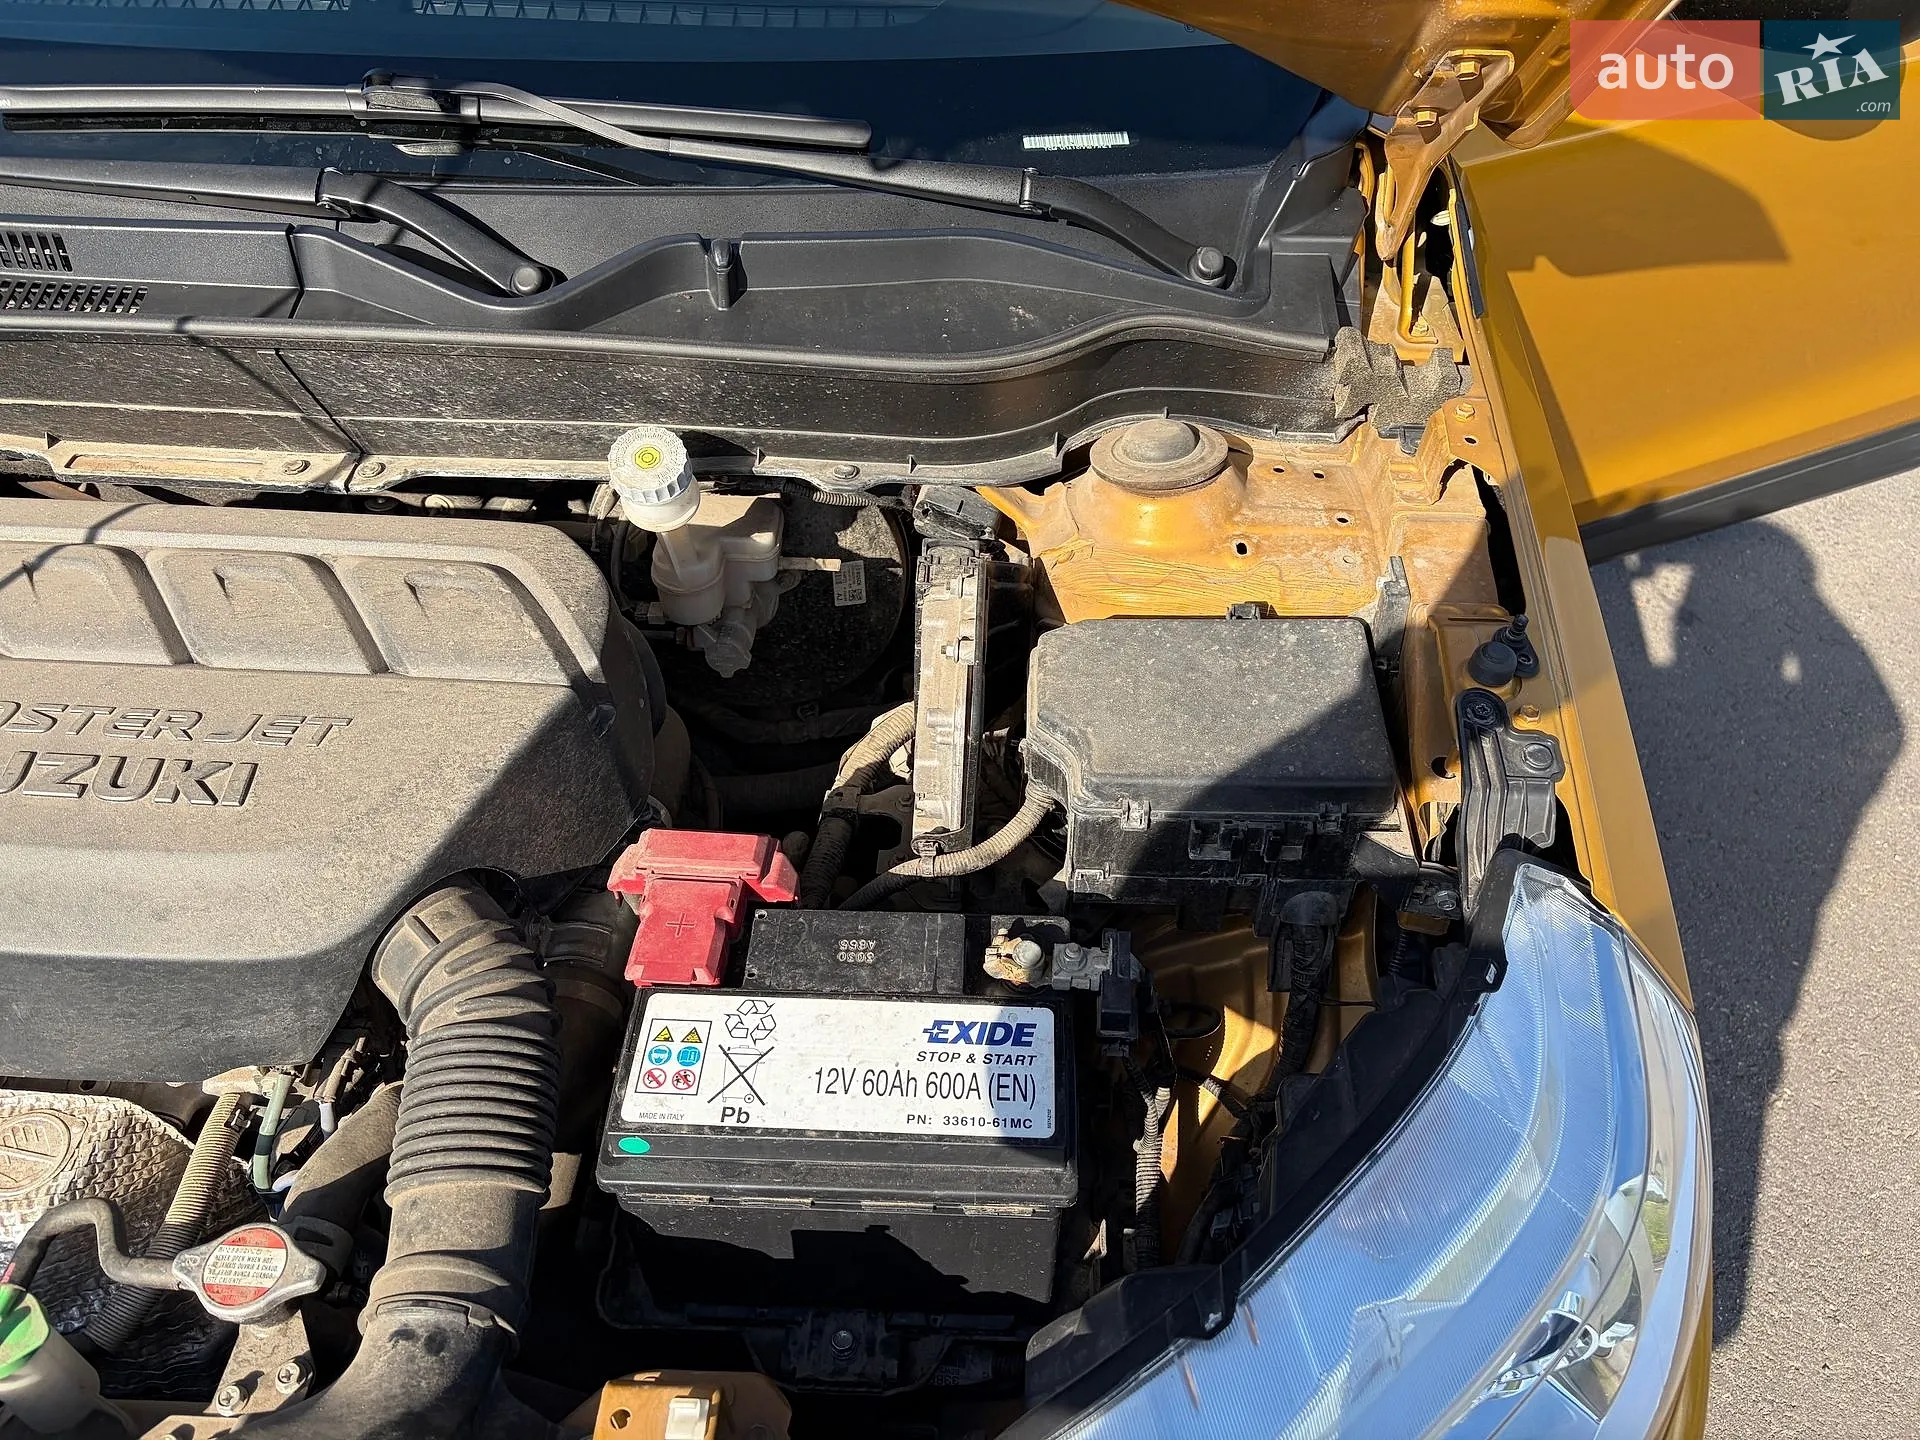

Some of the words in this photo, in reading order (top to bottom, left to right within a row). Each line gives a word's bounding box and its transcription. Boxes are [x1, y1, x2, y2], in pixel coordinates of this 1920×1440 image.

[203, 713, 354, 748] JET
[922, 1020, 1038, 1047] EXIDE
[916, 1051, 961, 1063] STOP
[966, 1054, 977, 1064] &
[982, 1054, 1038, 1066] START
[814, 1066, 857, 1095] 12V
[862, 1069, 918, 1098] 60Ah
[925, 1071, 982, 1100] 600A
[988, 1073, 1037, 1110] (EN)
[638, 1112, 658, 1120] MADE
[666, 1113, 685, 1121] ITALY
[720, 1106, 751, 1124] Pb
[906, 1114, 932, 1125] PN:
[943, 1116, 1033, 1129] 33610-61MC
